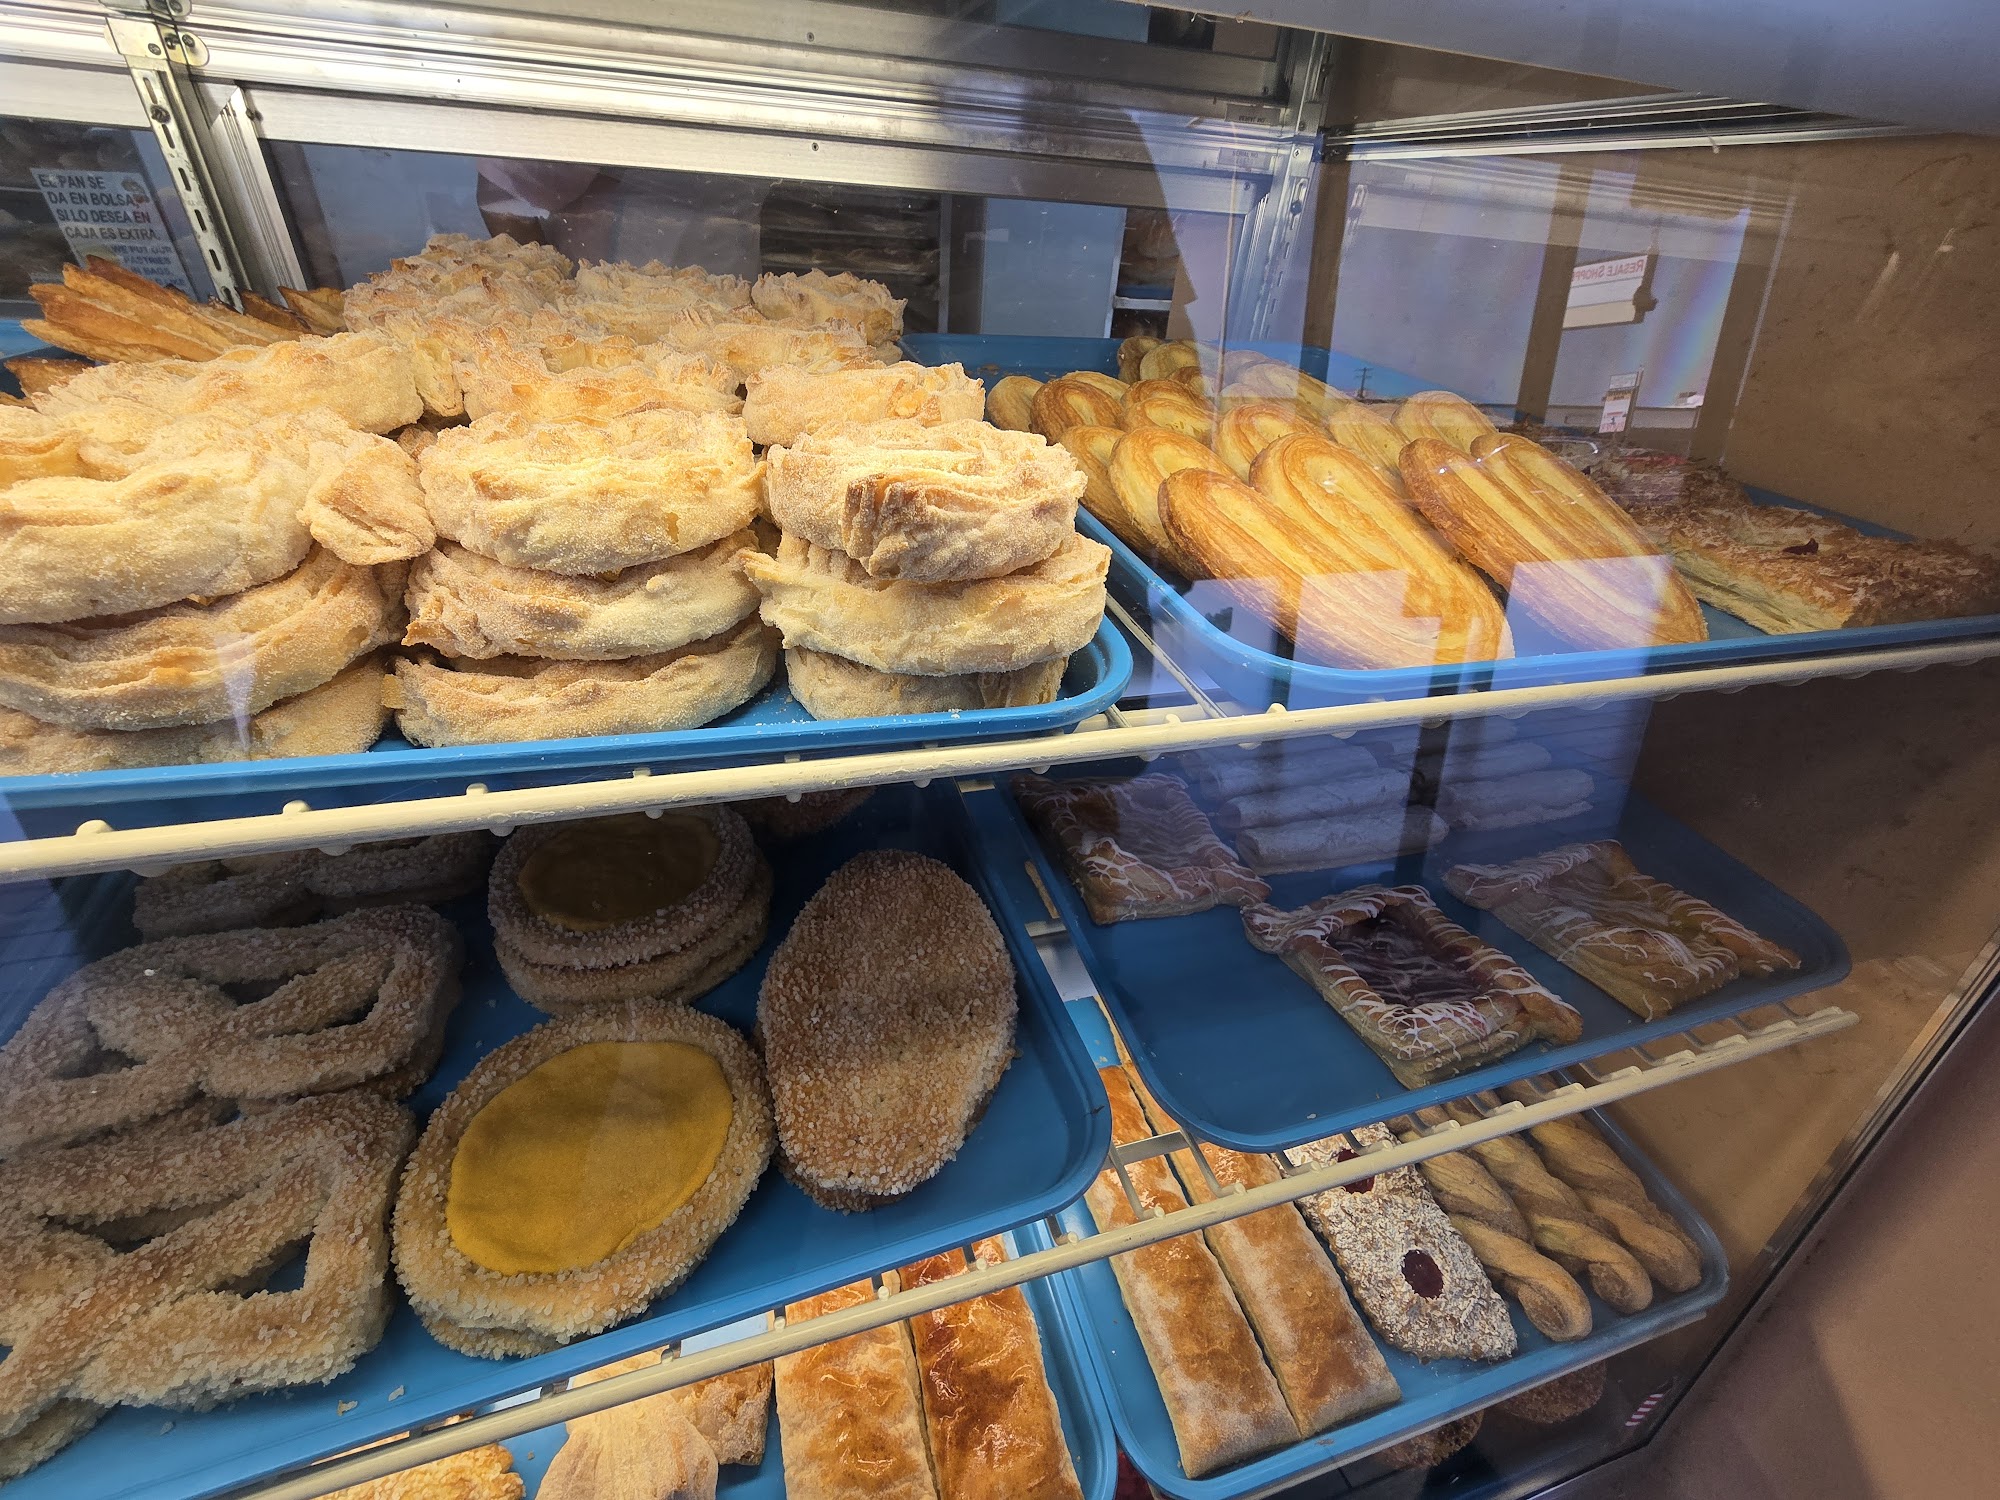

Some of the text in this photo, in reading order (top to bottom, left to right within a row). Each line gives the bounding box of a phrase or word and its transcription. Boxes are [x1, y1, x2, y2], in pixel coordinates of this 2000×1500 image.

[57, 175, 86, 189] PAN
[88, 176, 107, 190] SE
[47, 191, 69, 205] DA
[70, 192, 90, 206] EN
[57, 209, 153, 224] SI LO DESEA EN
[65, 227, 99, 240] CAJA
[100, 228, 118, 241] ES
